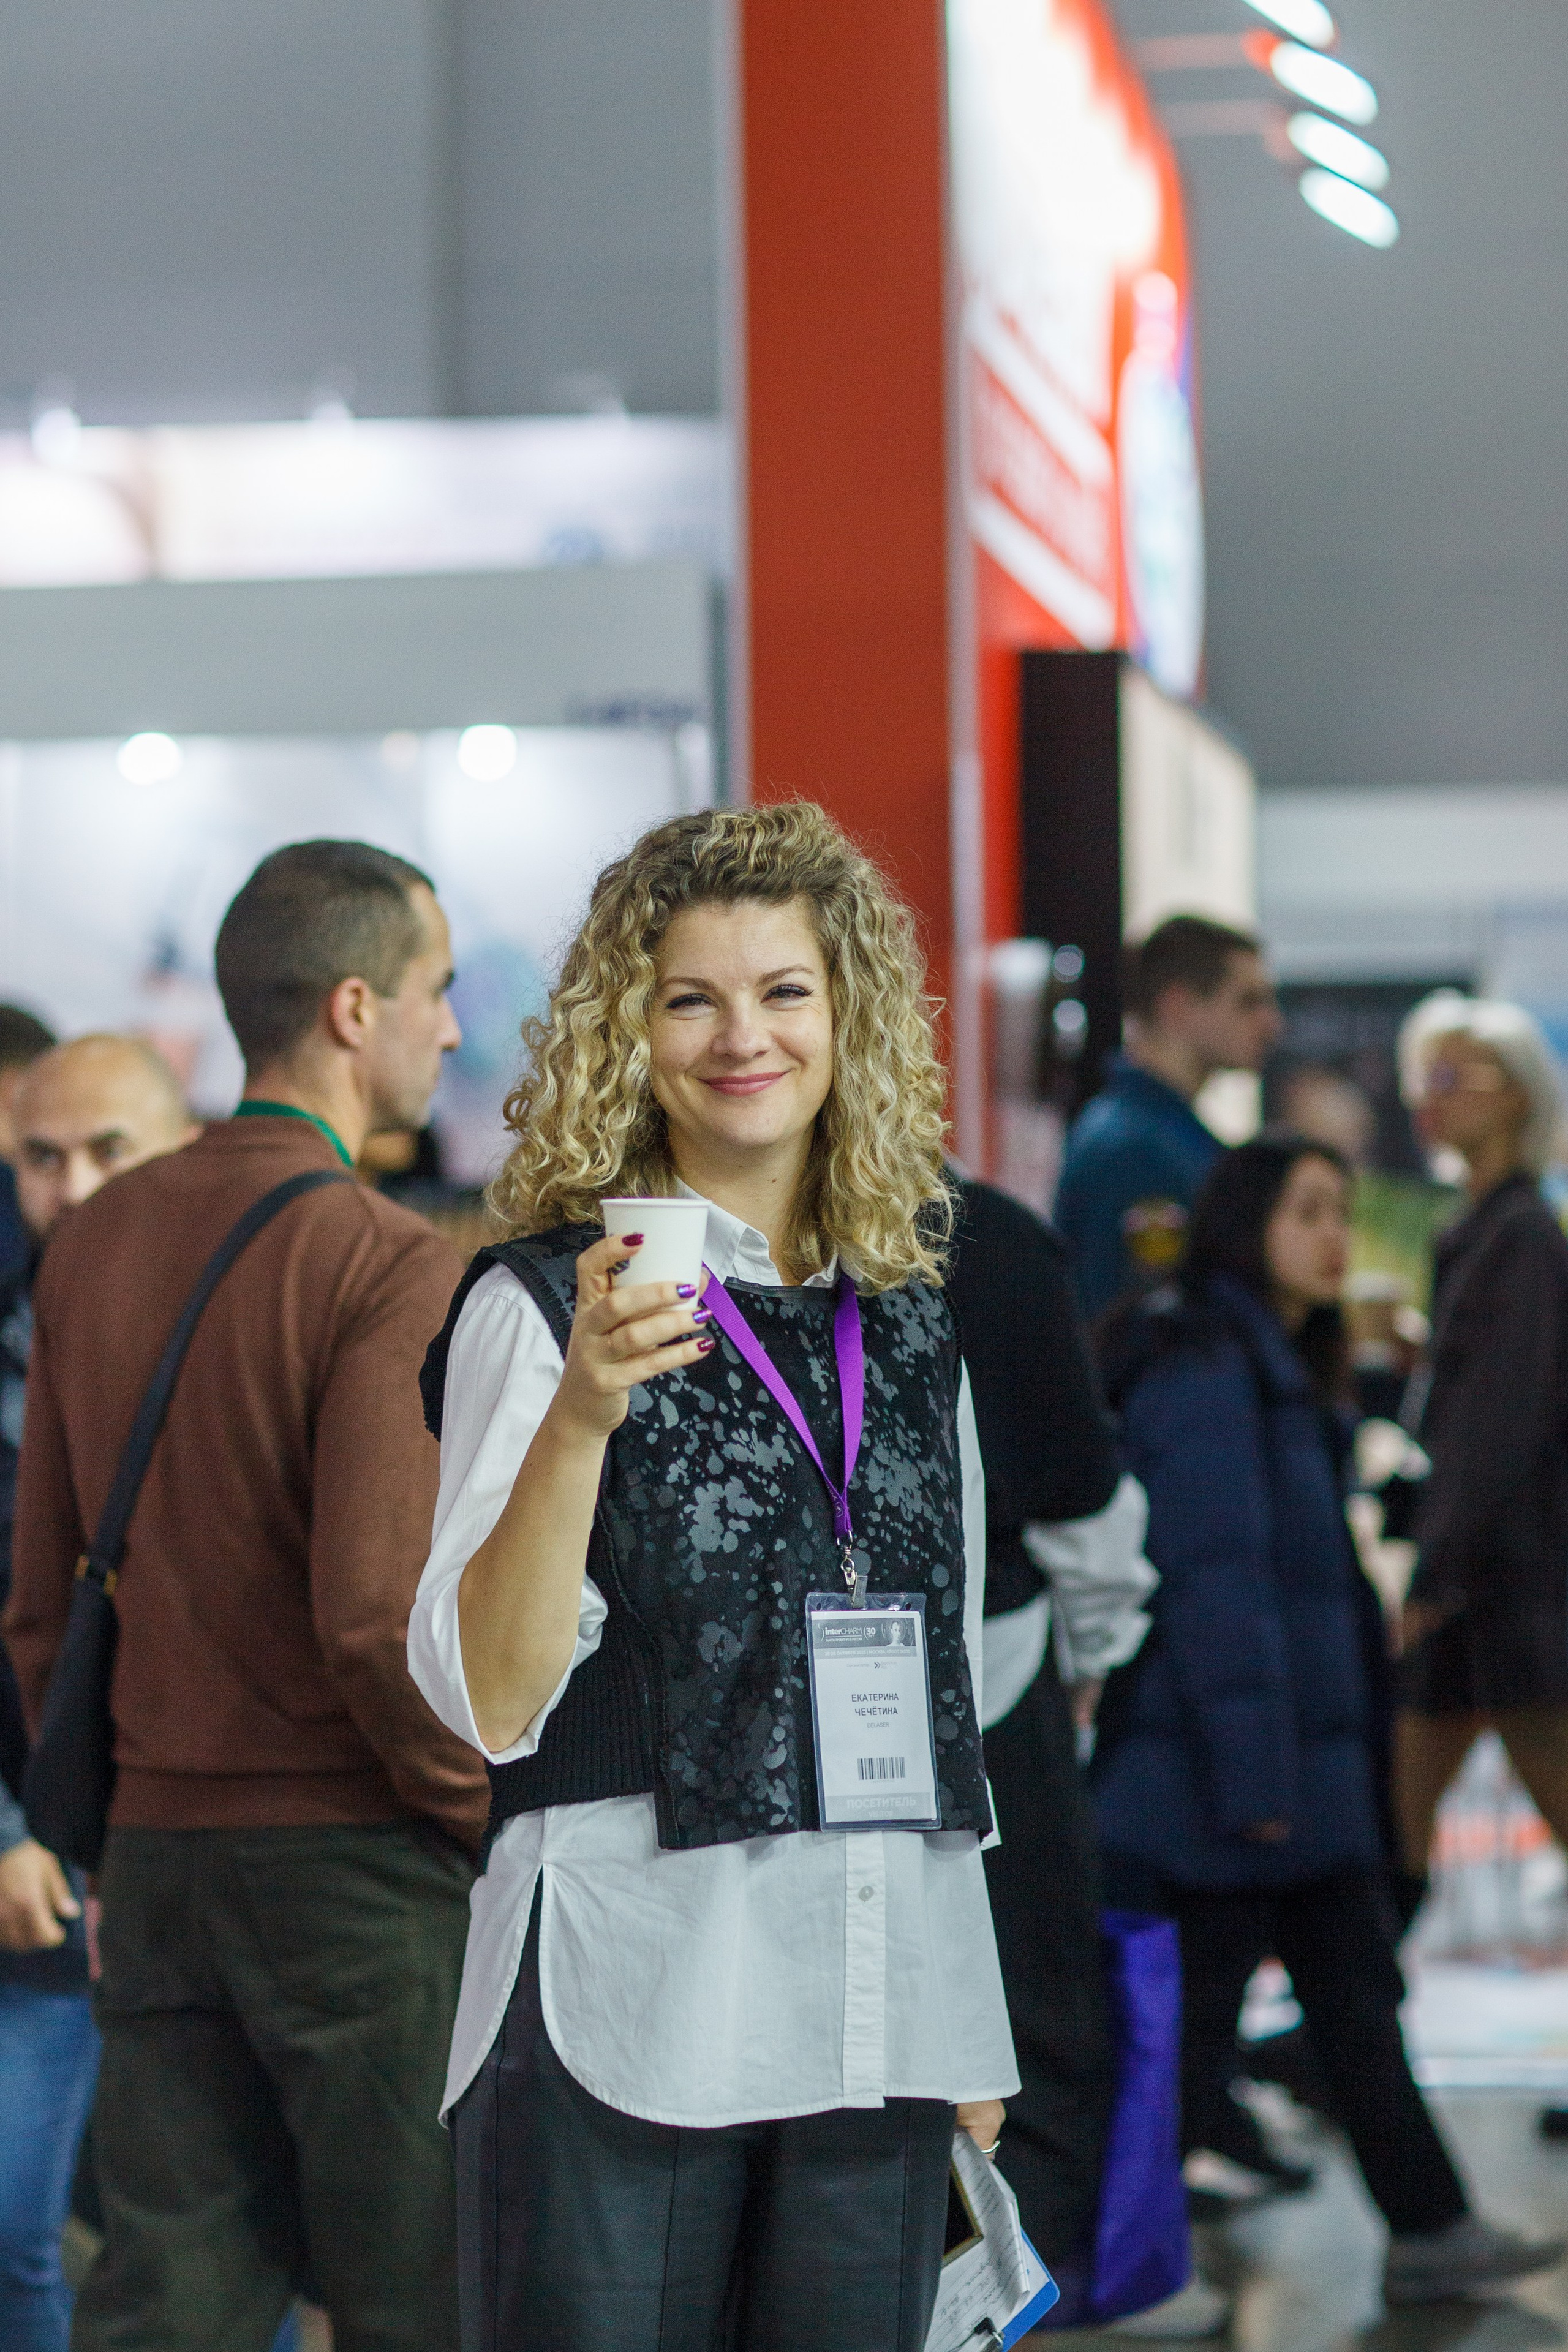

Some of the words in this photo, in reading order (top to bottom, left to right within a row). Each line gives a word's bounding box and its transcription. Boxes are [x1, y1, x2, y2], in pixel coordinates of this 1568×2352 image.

[825, 1627, 862, 1635] interCHARM
[851, 1693, 899, 1702] ЕКАТЕРИНА
[854, 1706, 898, 1716] ЧЕЧЁТИНА
[846, 1796, 916, 1809] ПОСЕТИТЕЛЬ
